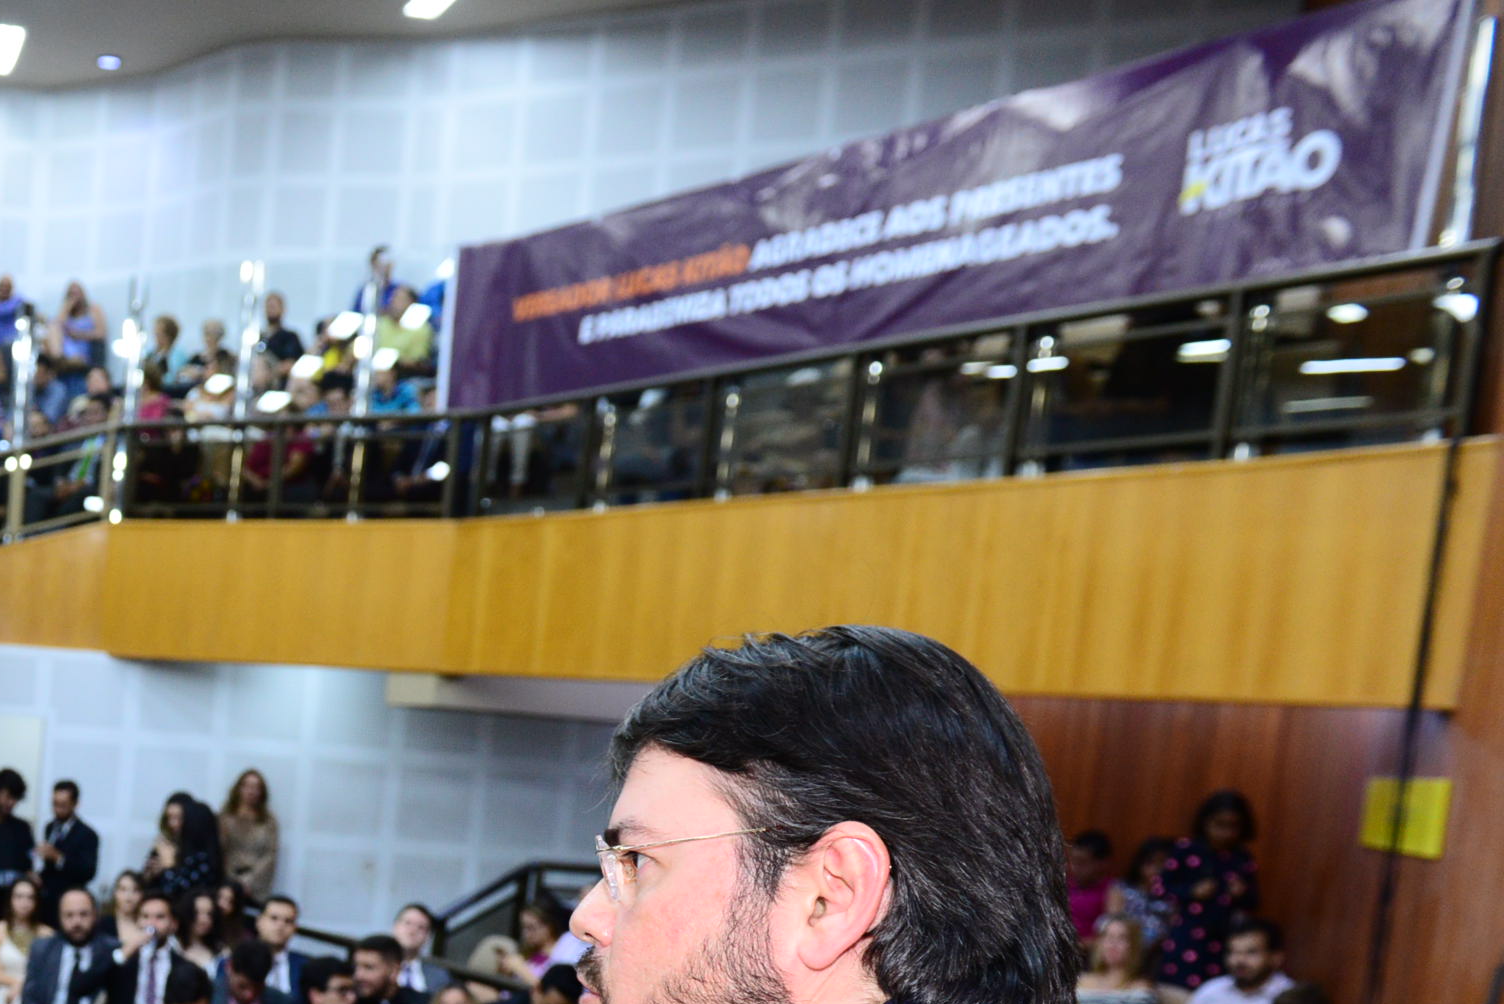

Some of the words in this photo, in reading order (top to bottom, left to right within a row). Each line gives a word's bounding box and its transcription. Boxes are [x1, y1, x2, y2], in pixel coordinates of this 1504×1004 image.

[1186, 106, 1294, 164] LUCAS
[747, 209, 885, 273] AGRADECE
[882, 194, 949, 241] AOS
[947, 152, 1124, 227] PRESENTES
[727, 268, 813, 317] TODOS
[810, 259, 850, 299] OS
